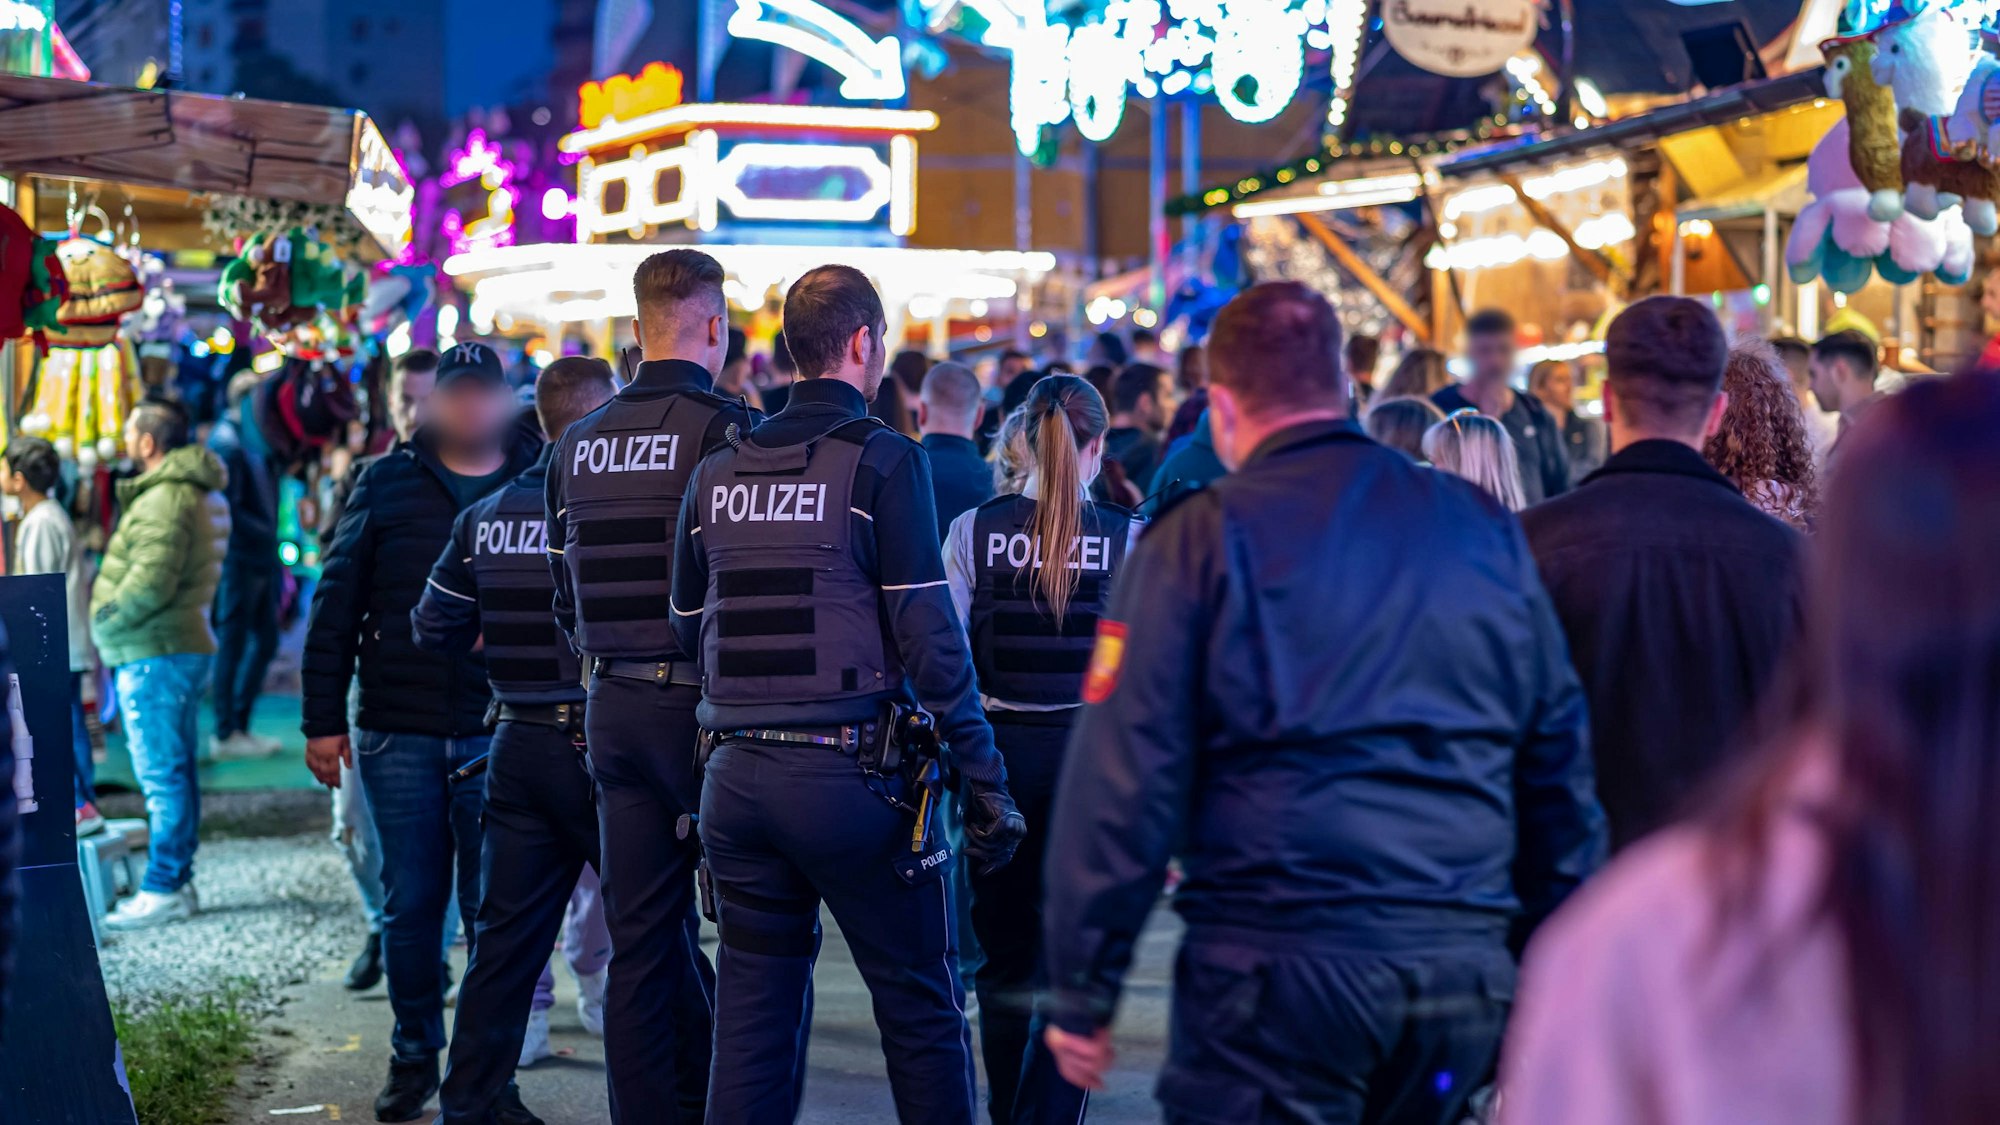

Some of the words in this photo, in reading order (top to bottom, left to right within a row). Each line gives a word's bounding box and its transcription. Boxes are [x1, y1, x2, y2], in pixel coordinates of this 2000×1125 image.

[573, 434, 679, 475] POLIZEI
[712, 484, 827, 523] POLIZEI
[475, 520, 548, 555] POLIZE
[987, 533, 1110, 571] POLZEI
[921, 849, 948, 870] POLIZEI
